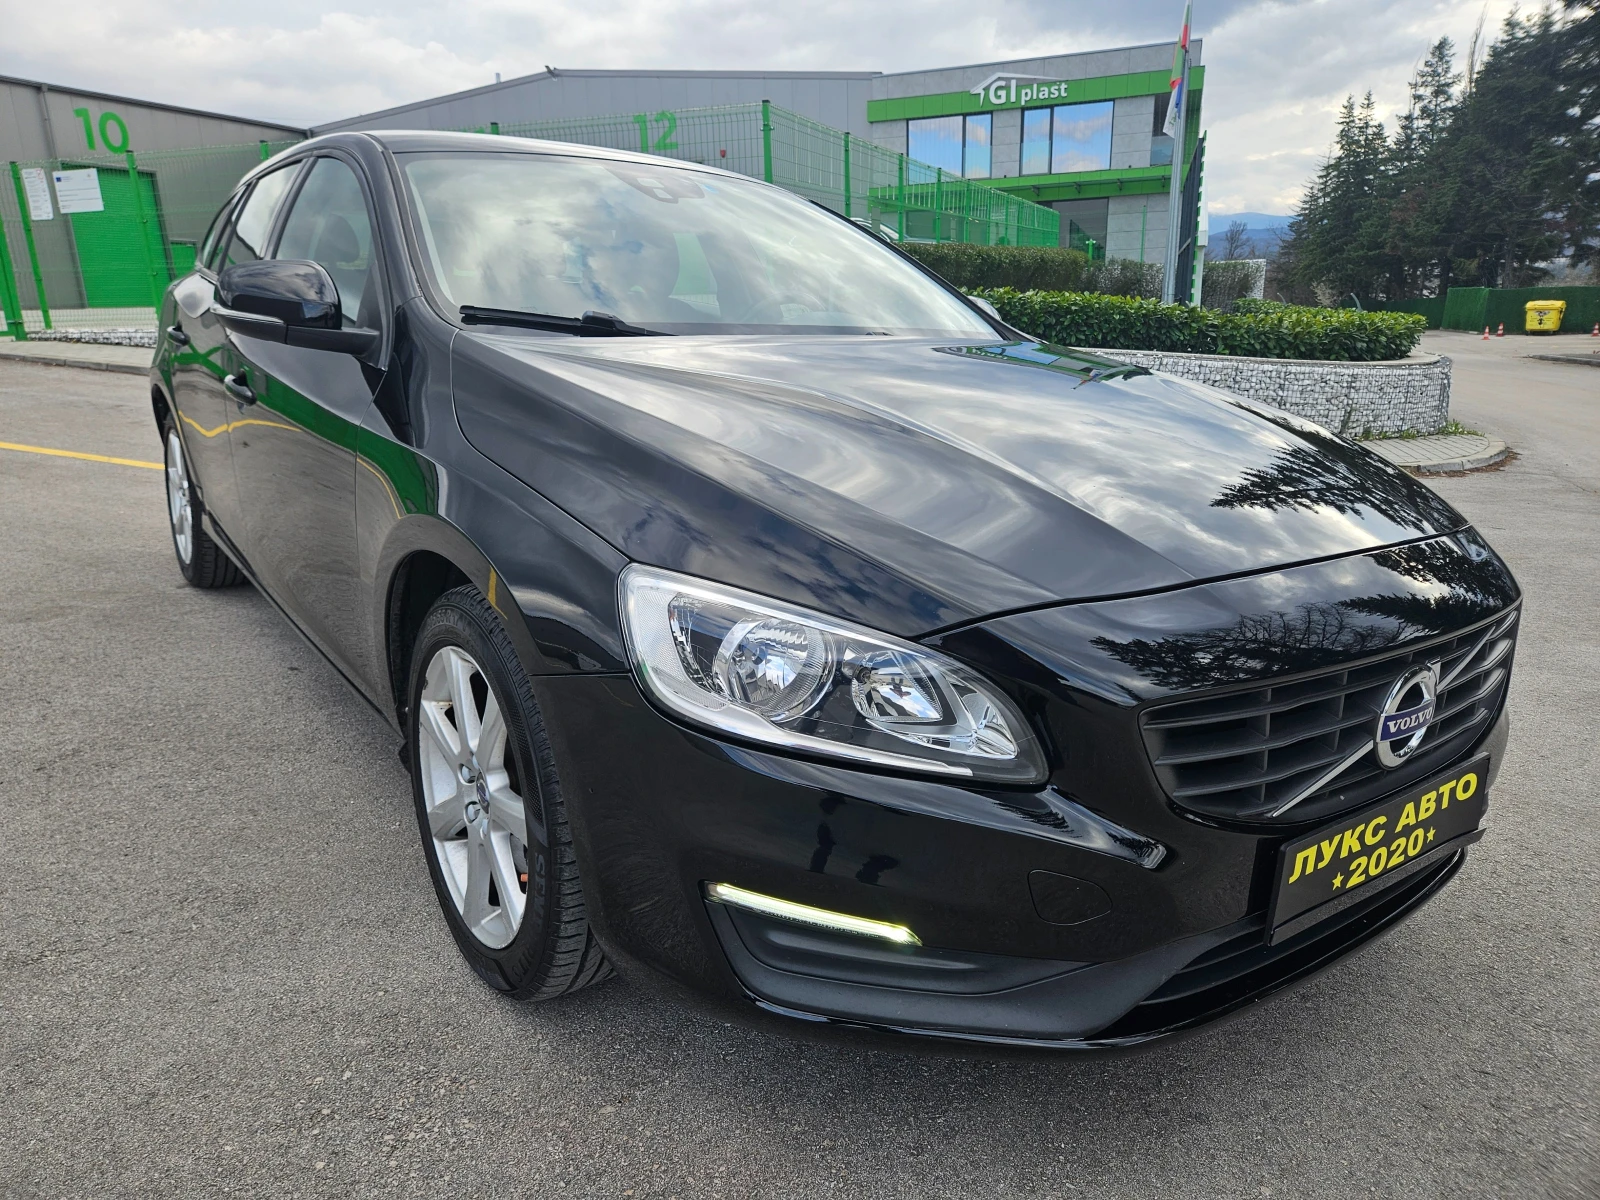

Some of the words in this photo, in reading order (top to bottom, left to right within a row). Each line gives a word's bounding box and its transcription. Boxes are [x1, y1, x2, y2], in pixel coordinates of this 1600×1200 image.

[988, 79, 1017, 104] GI
[1021, 82, 1068, 106] plast
[73, 107, 130, 154] 10
[633, 110, 679, 153] 12
[1386, 706, 1434, 733] VOLVO
[1288, 815, 1388, 884] ЛУКС
[1395, 772, 1478, 833] АВТО
[1345, 827, 1425, 889] 2020
